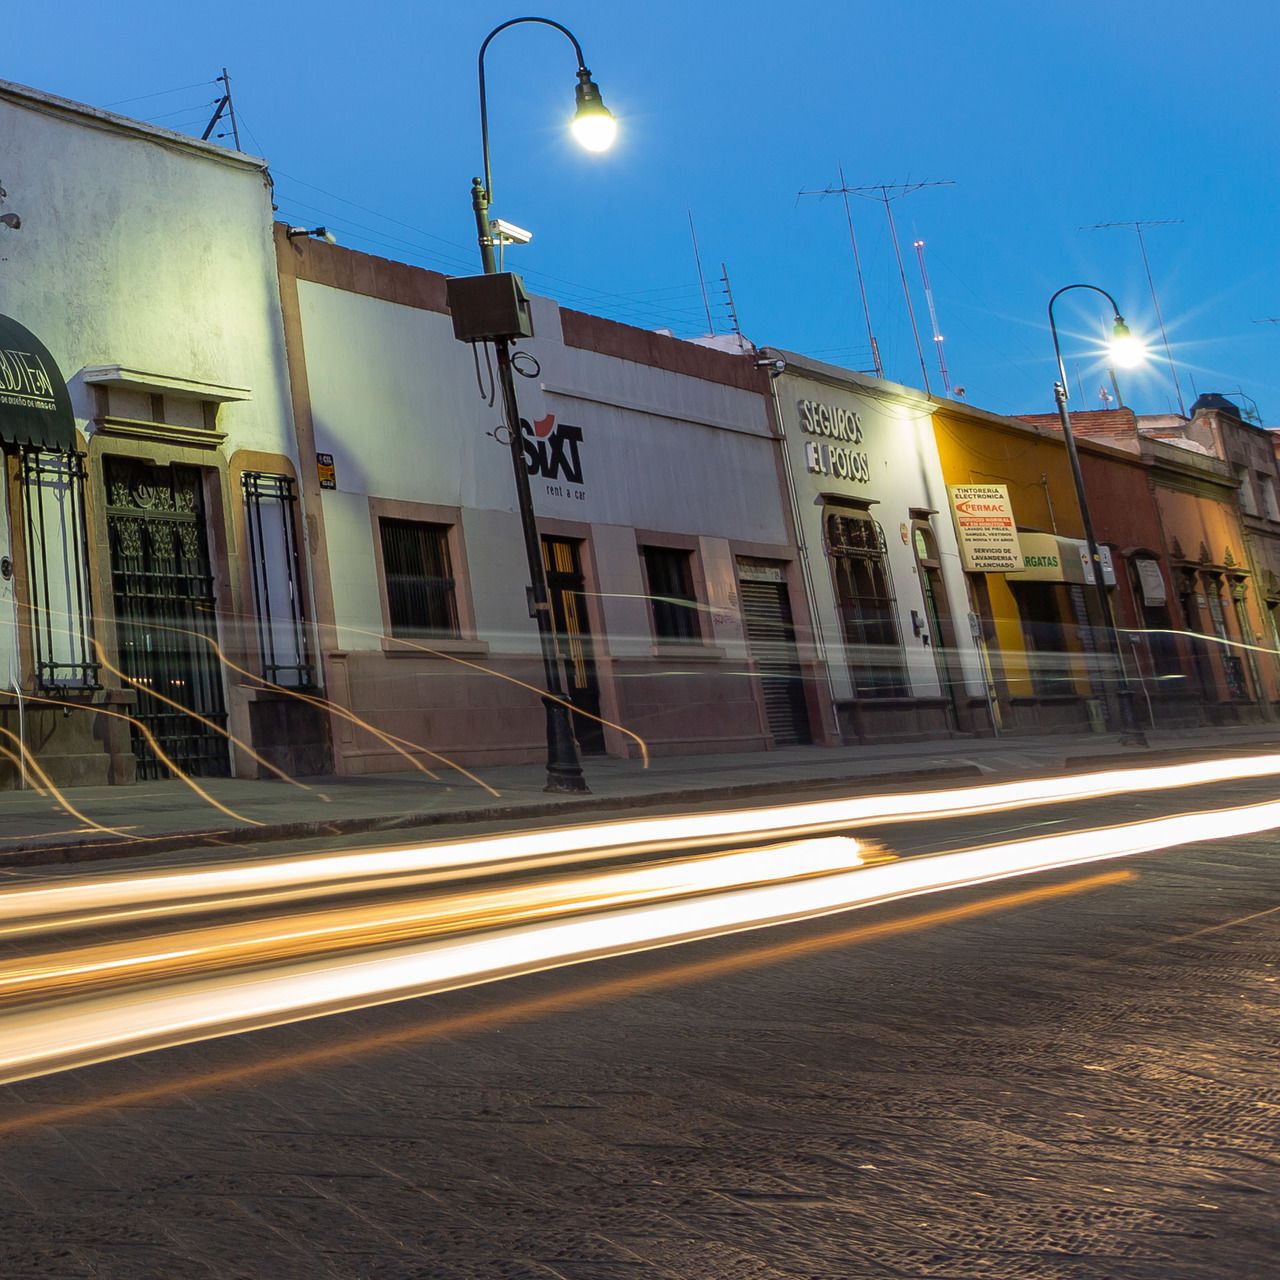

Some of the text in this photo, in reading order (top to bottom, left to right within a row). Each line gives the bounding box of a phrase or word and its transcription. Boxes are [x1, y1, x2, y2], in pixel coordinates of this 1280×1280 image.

[1, 395, 8, 404] DE
[8, 396, 27, 406] DISEÑO
[27, 399, 35, 408] DE
[801, 400, 864, 443] SEGUROS
[807, 441, 827, 473] EL
[546, 485, 586, 501] rent a car
[965, 504, 1005, 512] PERMAC
